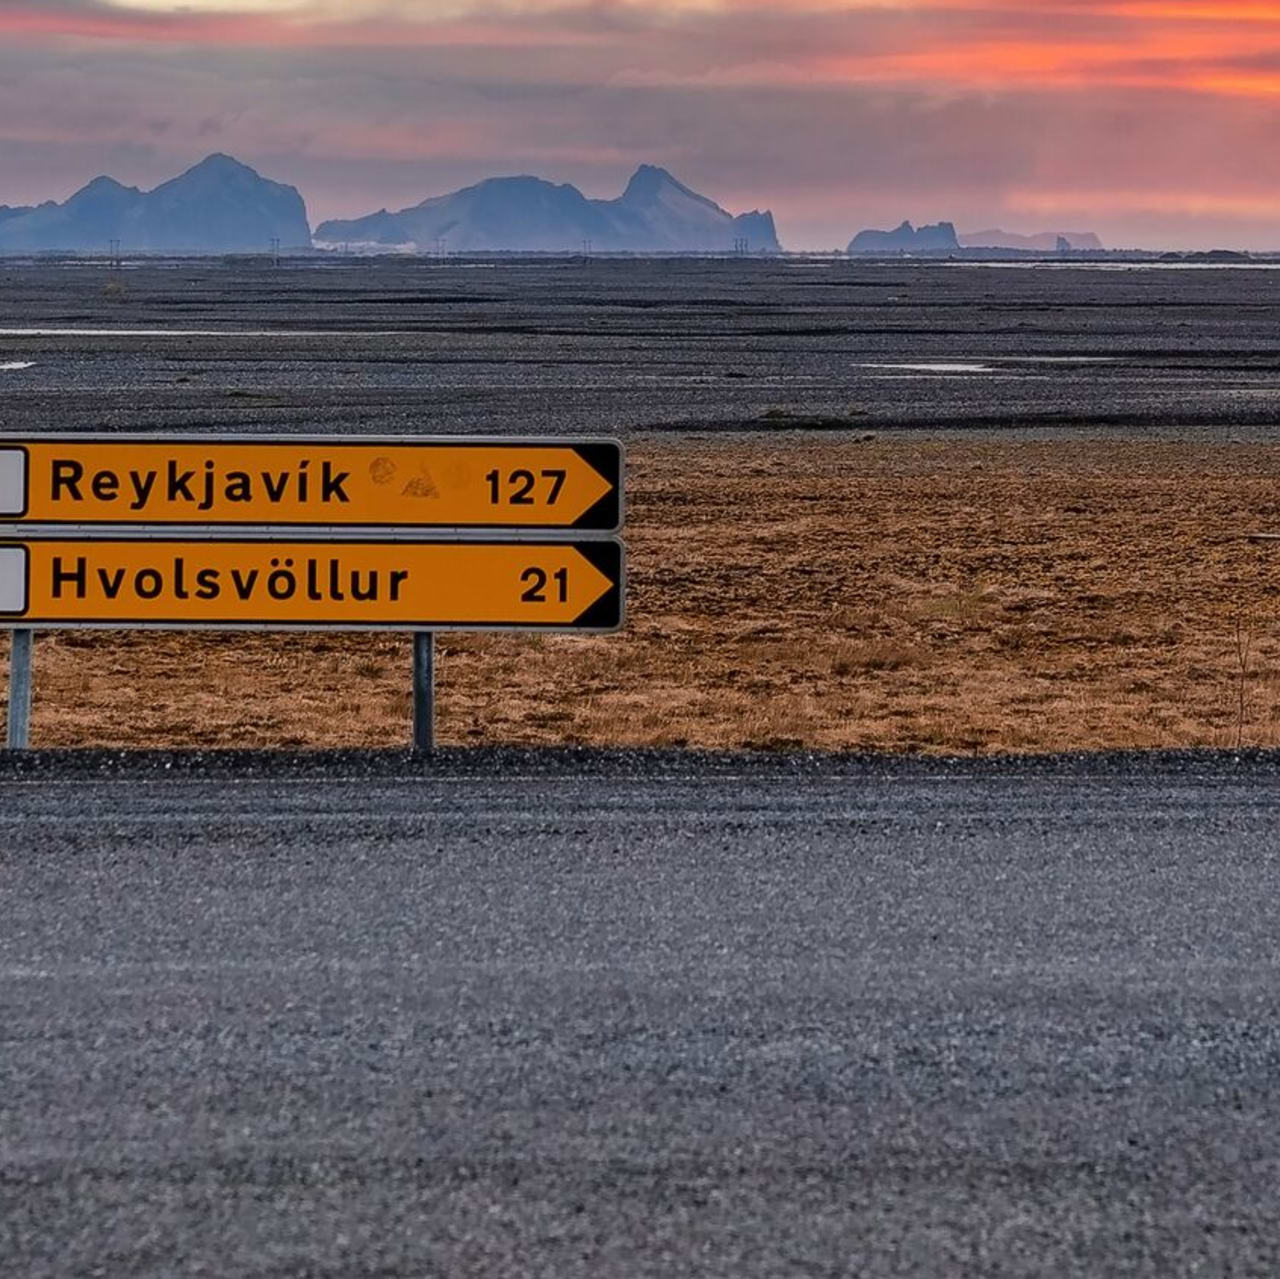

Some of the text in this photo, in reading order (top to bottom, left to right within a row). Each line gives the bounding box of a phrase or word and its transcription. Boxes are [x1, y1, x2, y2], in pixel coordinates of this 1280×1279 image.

[51, 459, 351, 511] Reykjavík
[484, 469, 568, 505] 127
[52, 556, 409, 603] Hvolsvöllur
[519, 566, 569, 603] 21
